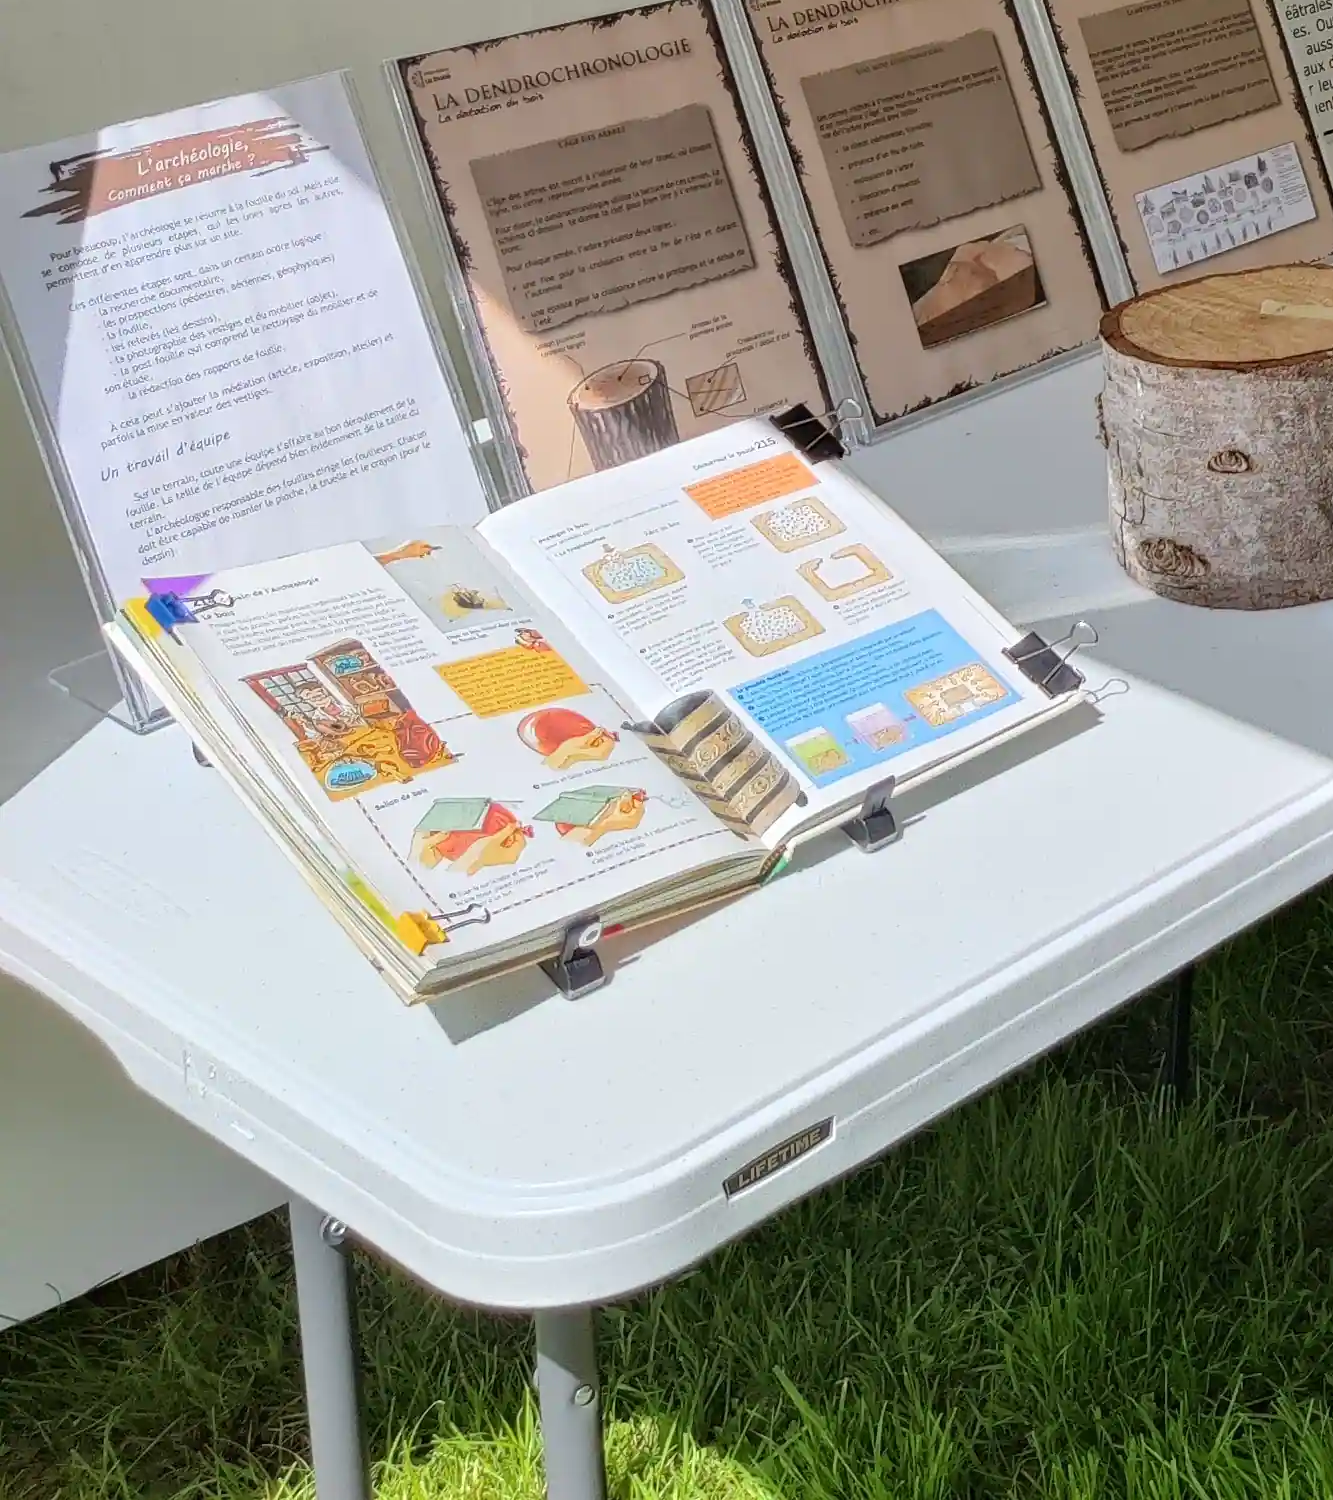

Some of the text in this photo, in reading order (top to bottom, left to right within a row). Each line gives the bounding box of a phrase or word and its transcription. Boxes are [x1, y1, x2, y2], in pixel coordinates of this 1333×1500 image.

[108, 176, 173, 202] Comment
[177, 173, 192, 186] ça
[101, 431, 231, 482] Un travail d'équipe
[738, 1128, 822, 1188] LIFETIME
